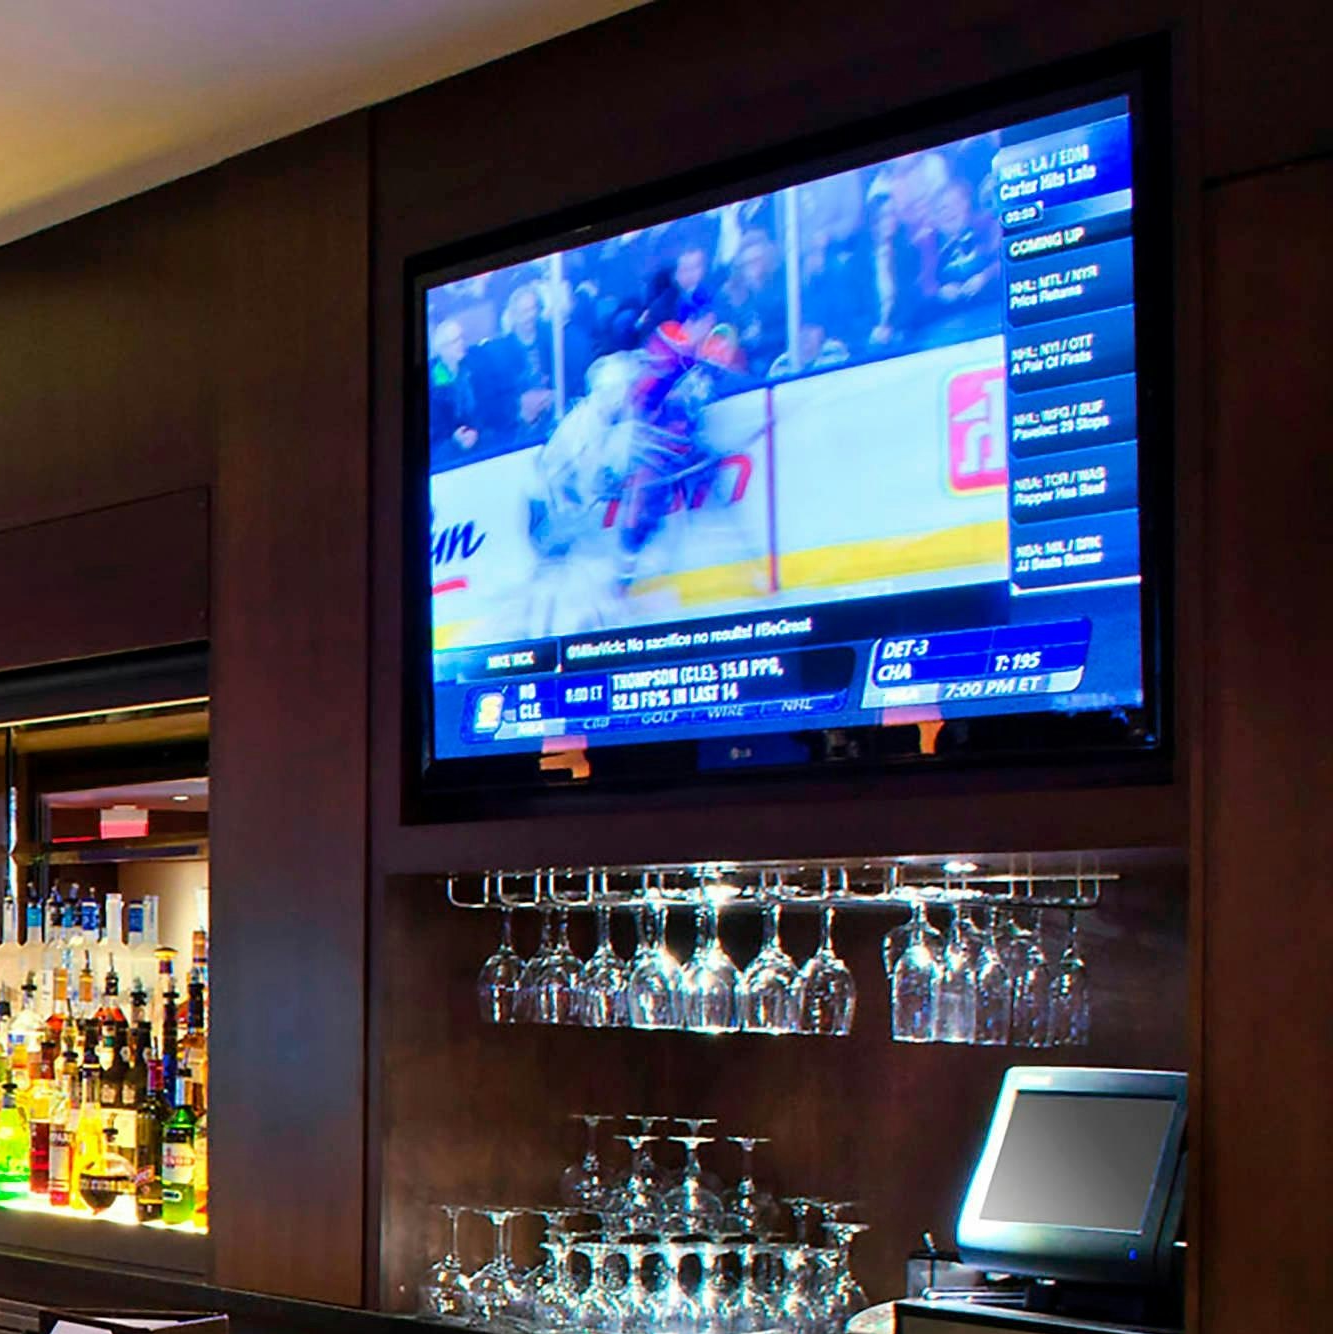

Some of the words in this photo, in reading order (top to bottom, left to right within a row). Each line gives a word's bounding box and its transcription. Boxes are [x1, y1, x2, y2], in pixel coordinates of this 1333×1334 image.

[1031, 155, 1048, 173] LA
[1009, 231, 1063, 257] COMING
[1064, 226, 1085, 244] UP
[1068, 333, 1094, 351] OTT
[1010, 362, 1021, 376] A
[627, 638, 644, 652] No
[645, 632, 692, 651] sacrifice
[693, 632, 709, 645] no
[882, 638, 930, 660] DET-3
[995, 654, 1010, 672] T:
[1012, 651, 1042, 670] 195
[611, 666, 679, 692] THOMPSON
[877, 663, 913, 682] CHA
[641, 687, 671, 708] FG%
[672, 686, 688, 705] IN
[689, 683, 720, 703] LAST
[721, 682, 739, 702] 14
[944, 681, 981, 699] 7:00
[983, 678, 1016, 696] PM
[1018, 675, 1042, 692] ET
[519, 702, 542, 720] CLE
[641, 710, 680, 725] GOLF
[707, 705, 745, 720] WIRE
[781, 698, 813, 713] NHL
